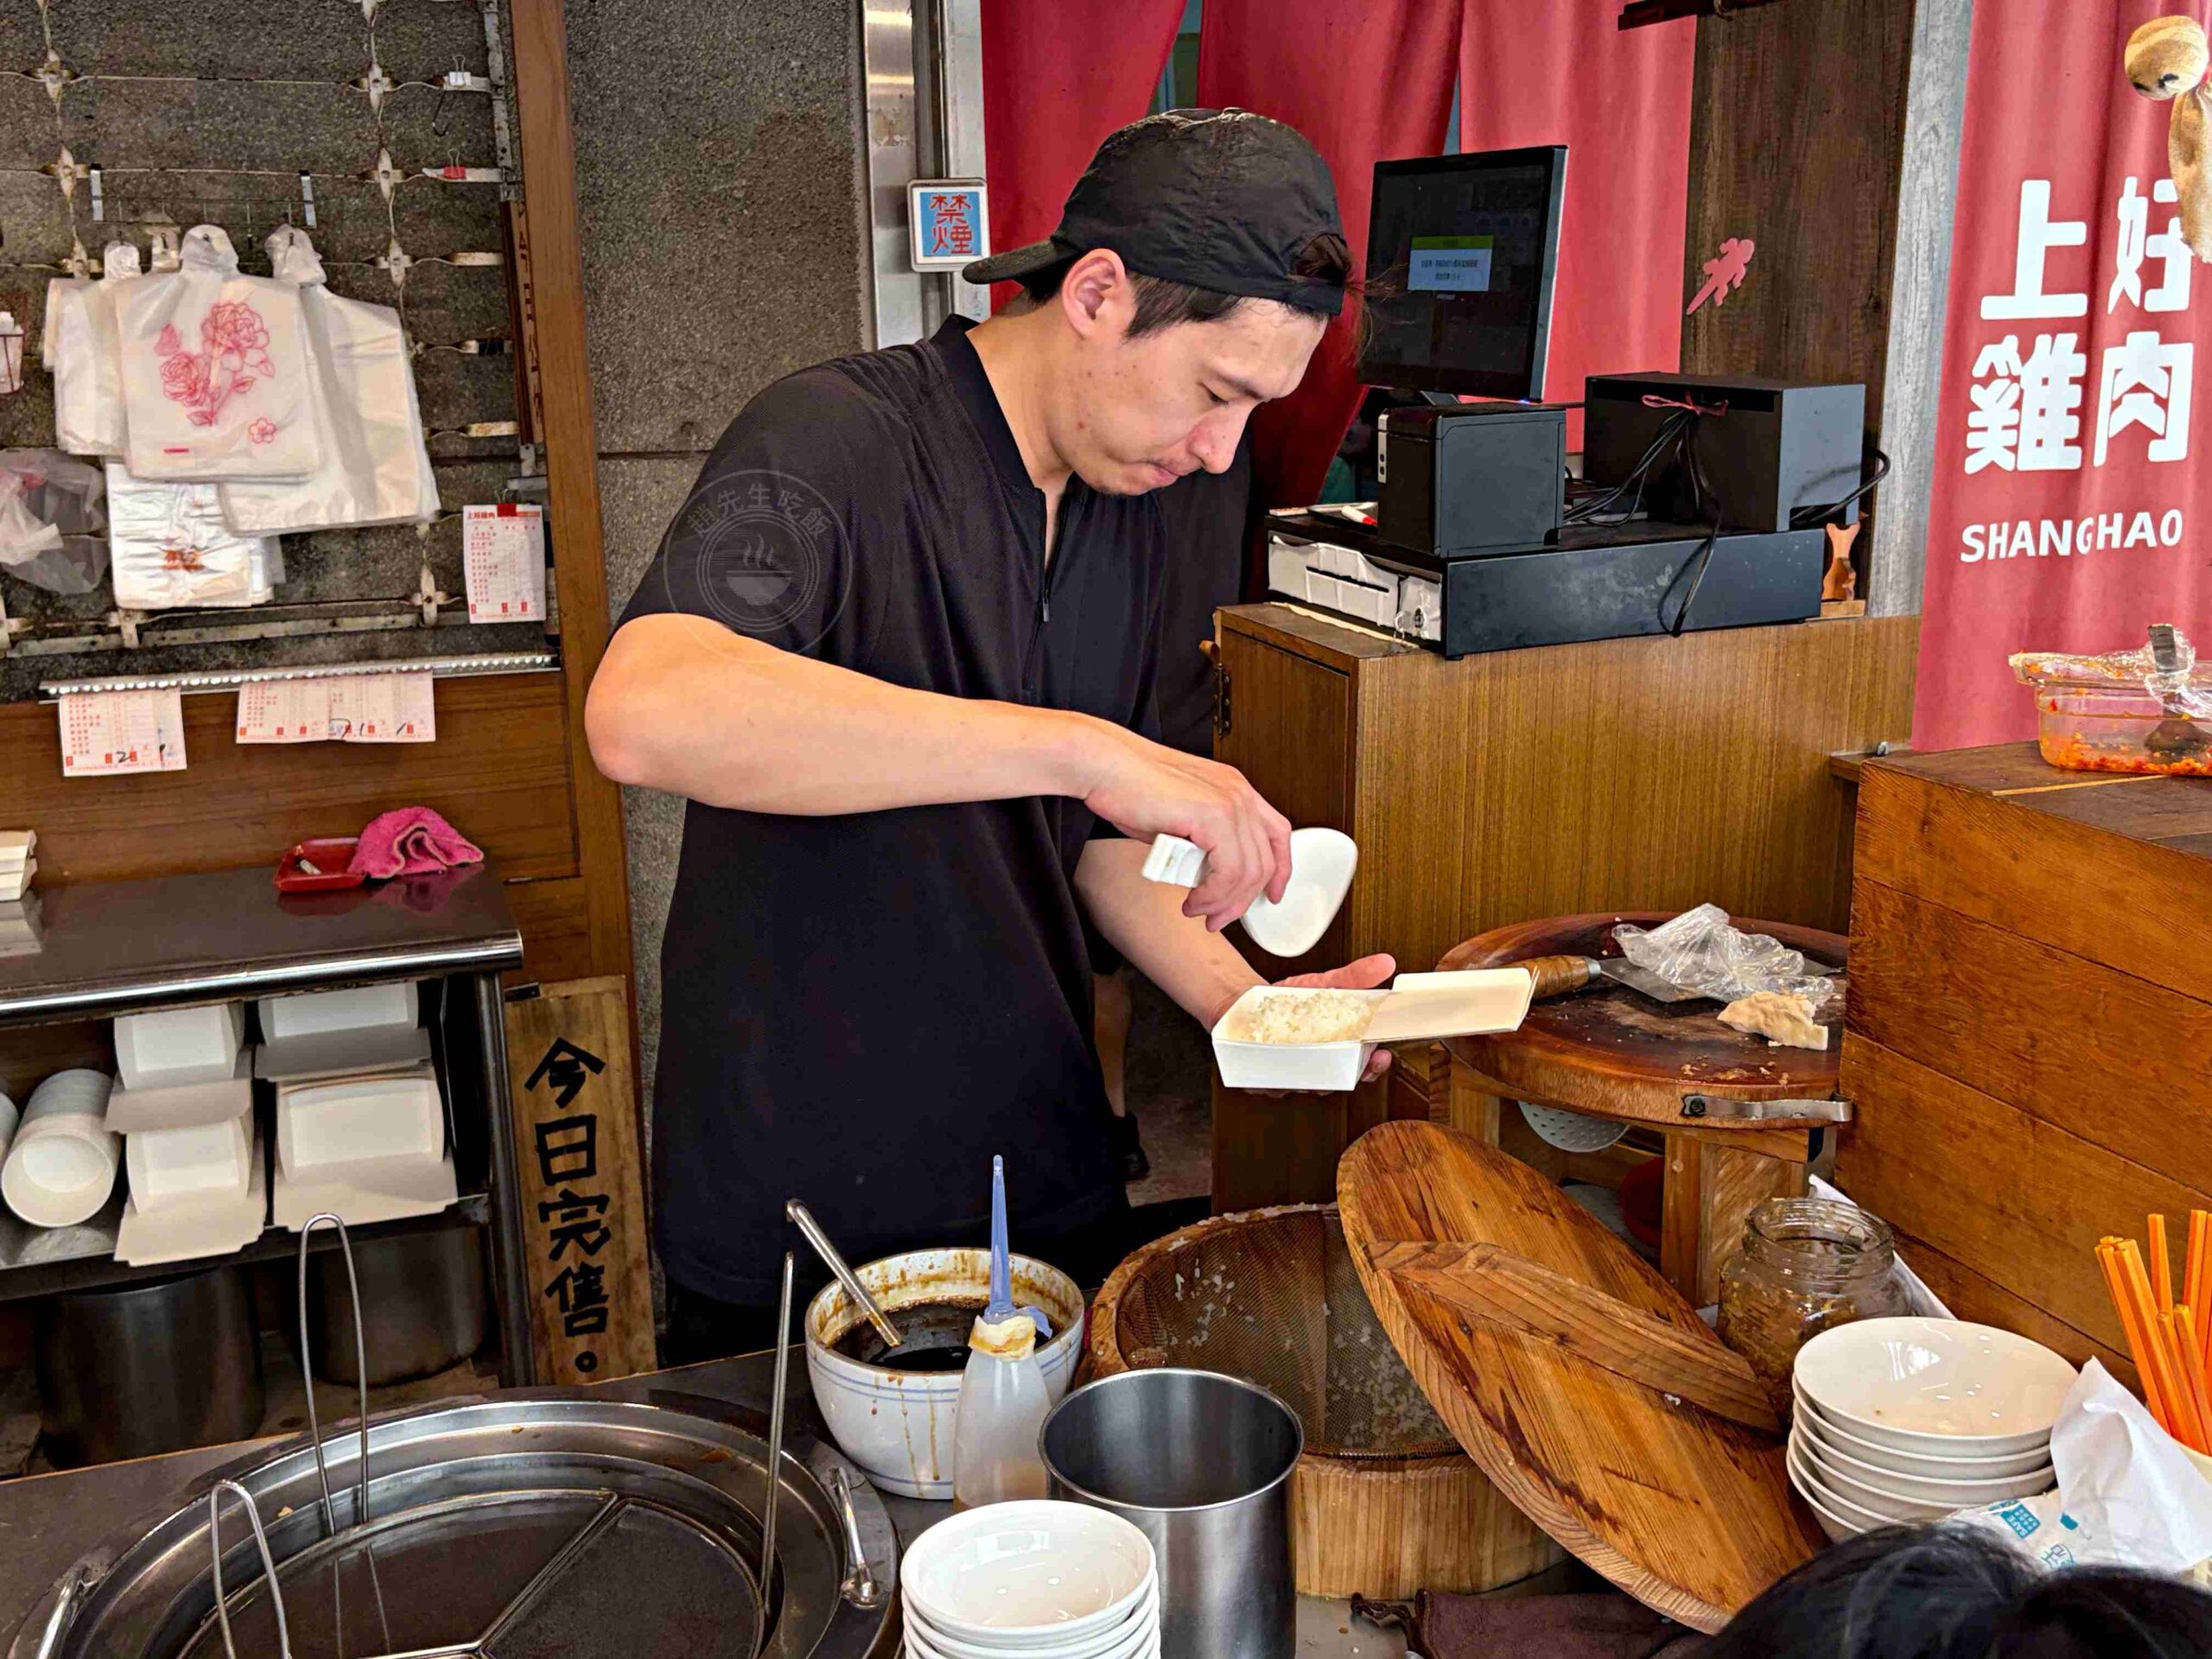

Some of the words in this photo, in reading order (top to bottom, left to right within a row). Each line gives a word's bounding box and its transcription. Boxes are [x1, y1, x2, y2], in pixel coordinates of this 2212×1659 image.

[929, 194, 973, 255] 禁煙
[1964, 331, 2194, 474] 雞肉
[1961, 509, 2183, 563] SHANGHAO
